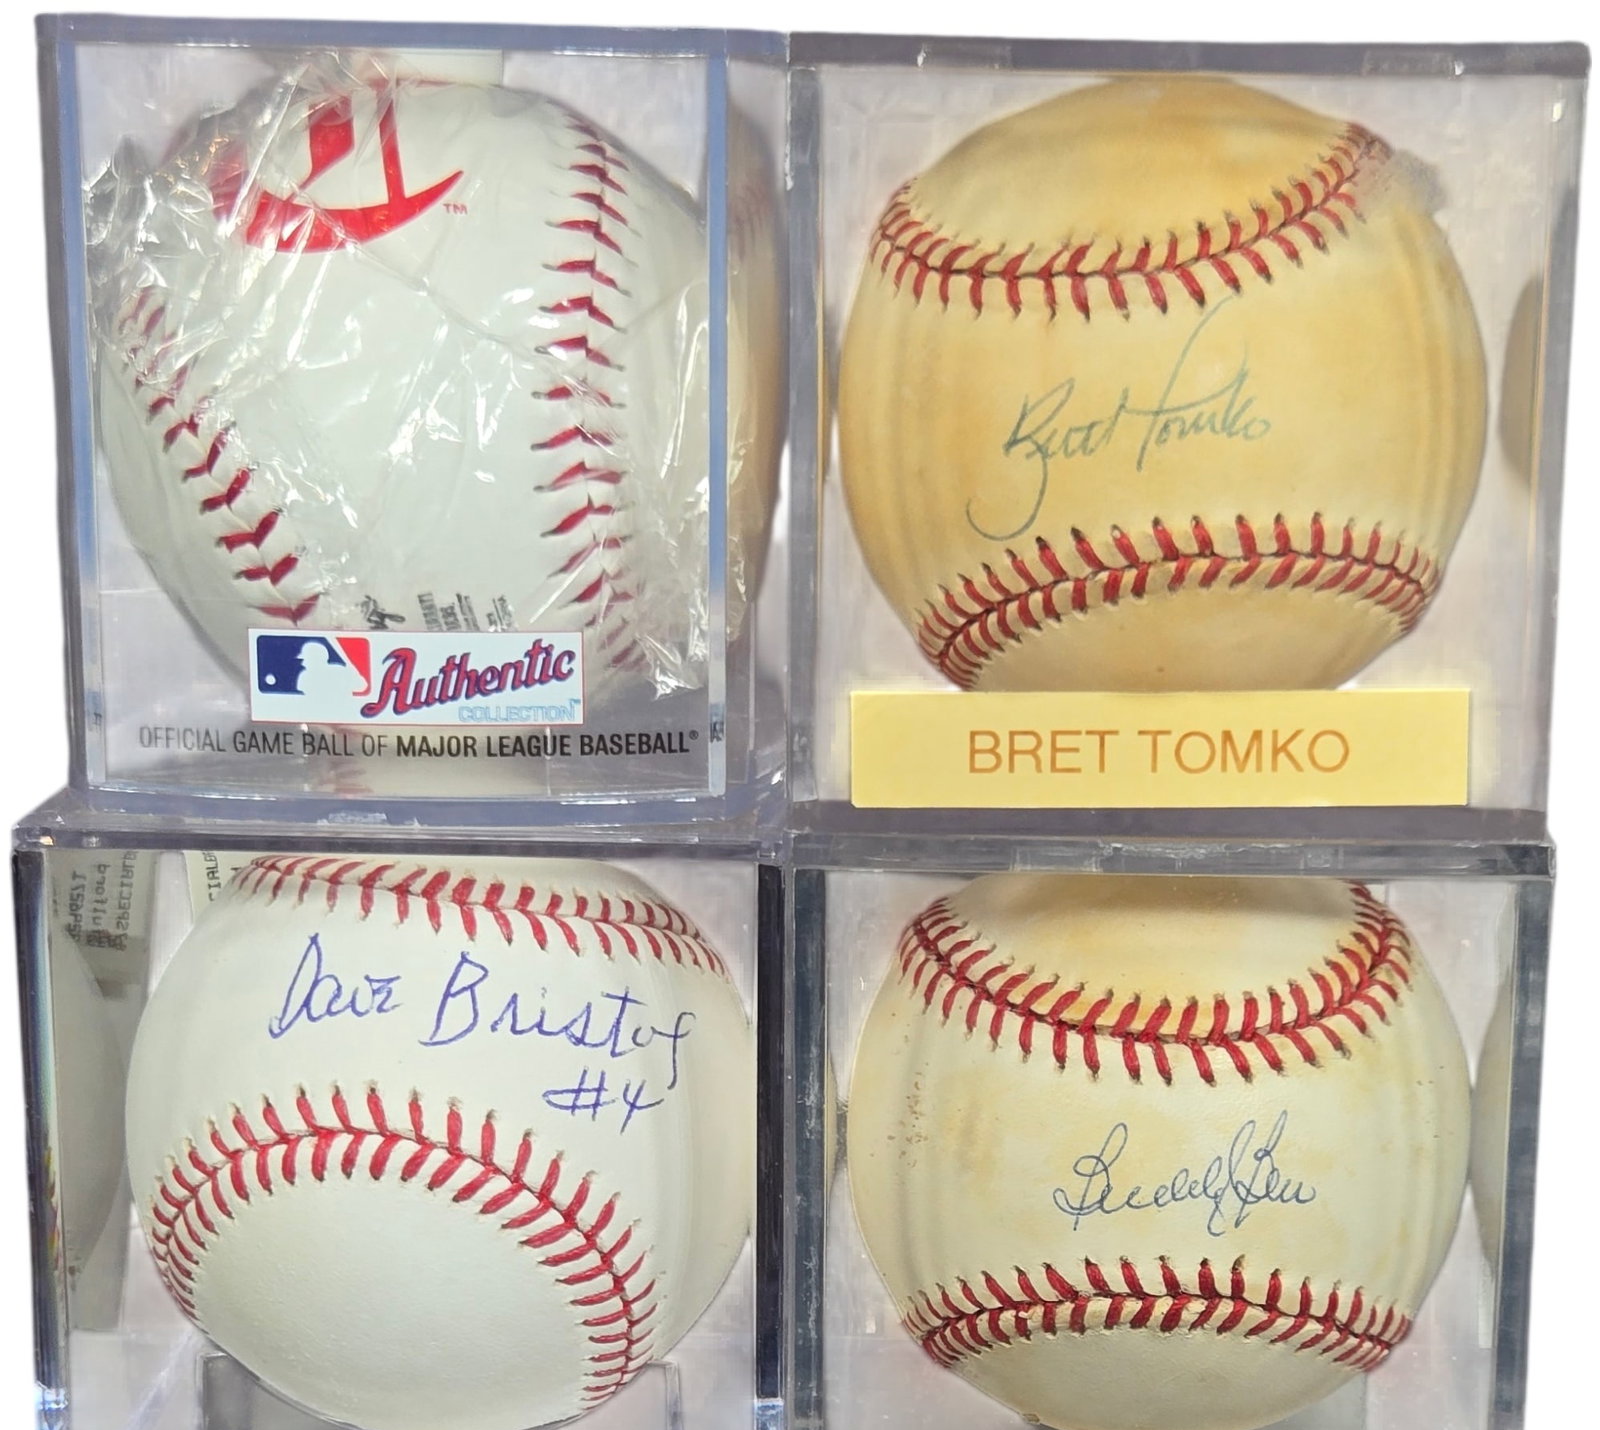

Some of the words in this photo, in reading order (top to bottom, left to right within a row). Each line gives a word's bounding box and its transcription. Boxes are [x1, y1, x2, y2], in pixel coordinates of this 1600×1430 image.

[360, 637, 576, 718] Authentic
[138, 726, 226, 751] OFFICIAL
[233, 730, 295, 755] GAME
[302, 732, 354, 757] BALL
[361, 735, 388, 757] OF
[396, 735, 478, 758] MAJOR
[486, 734, 571, 758] LEAGUE
[968, 729, 1120, 774] BRET
[1137, 729, 1350, 775] TOMKO
[542, 1066, 665, 1134] #4
